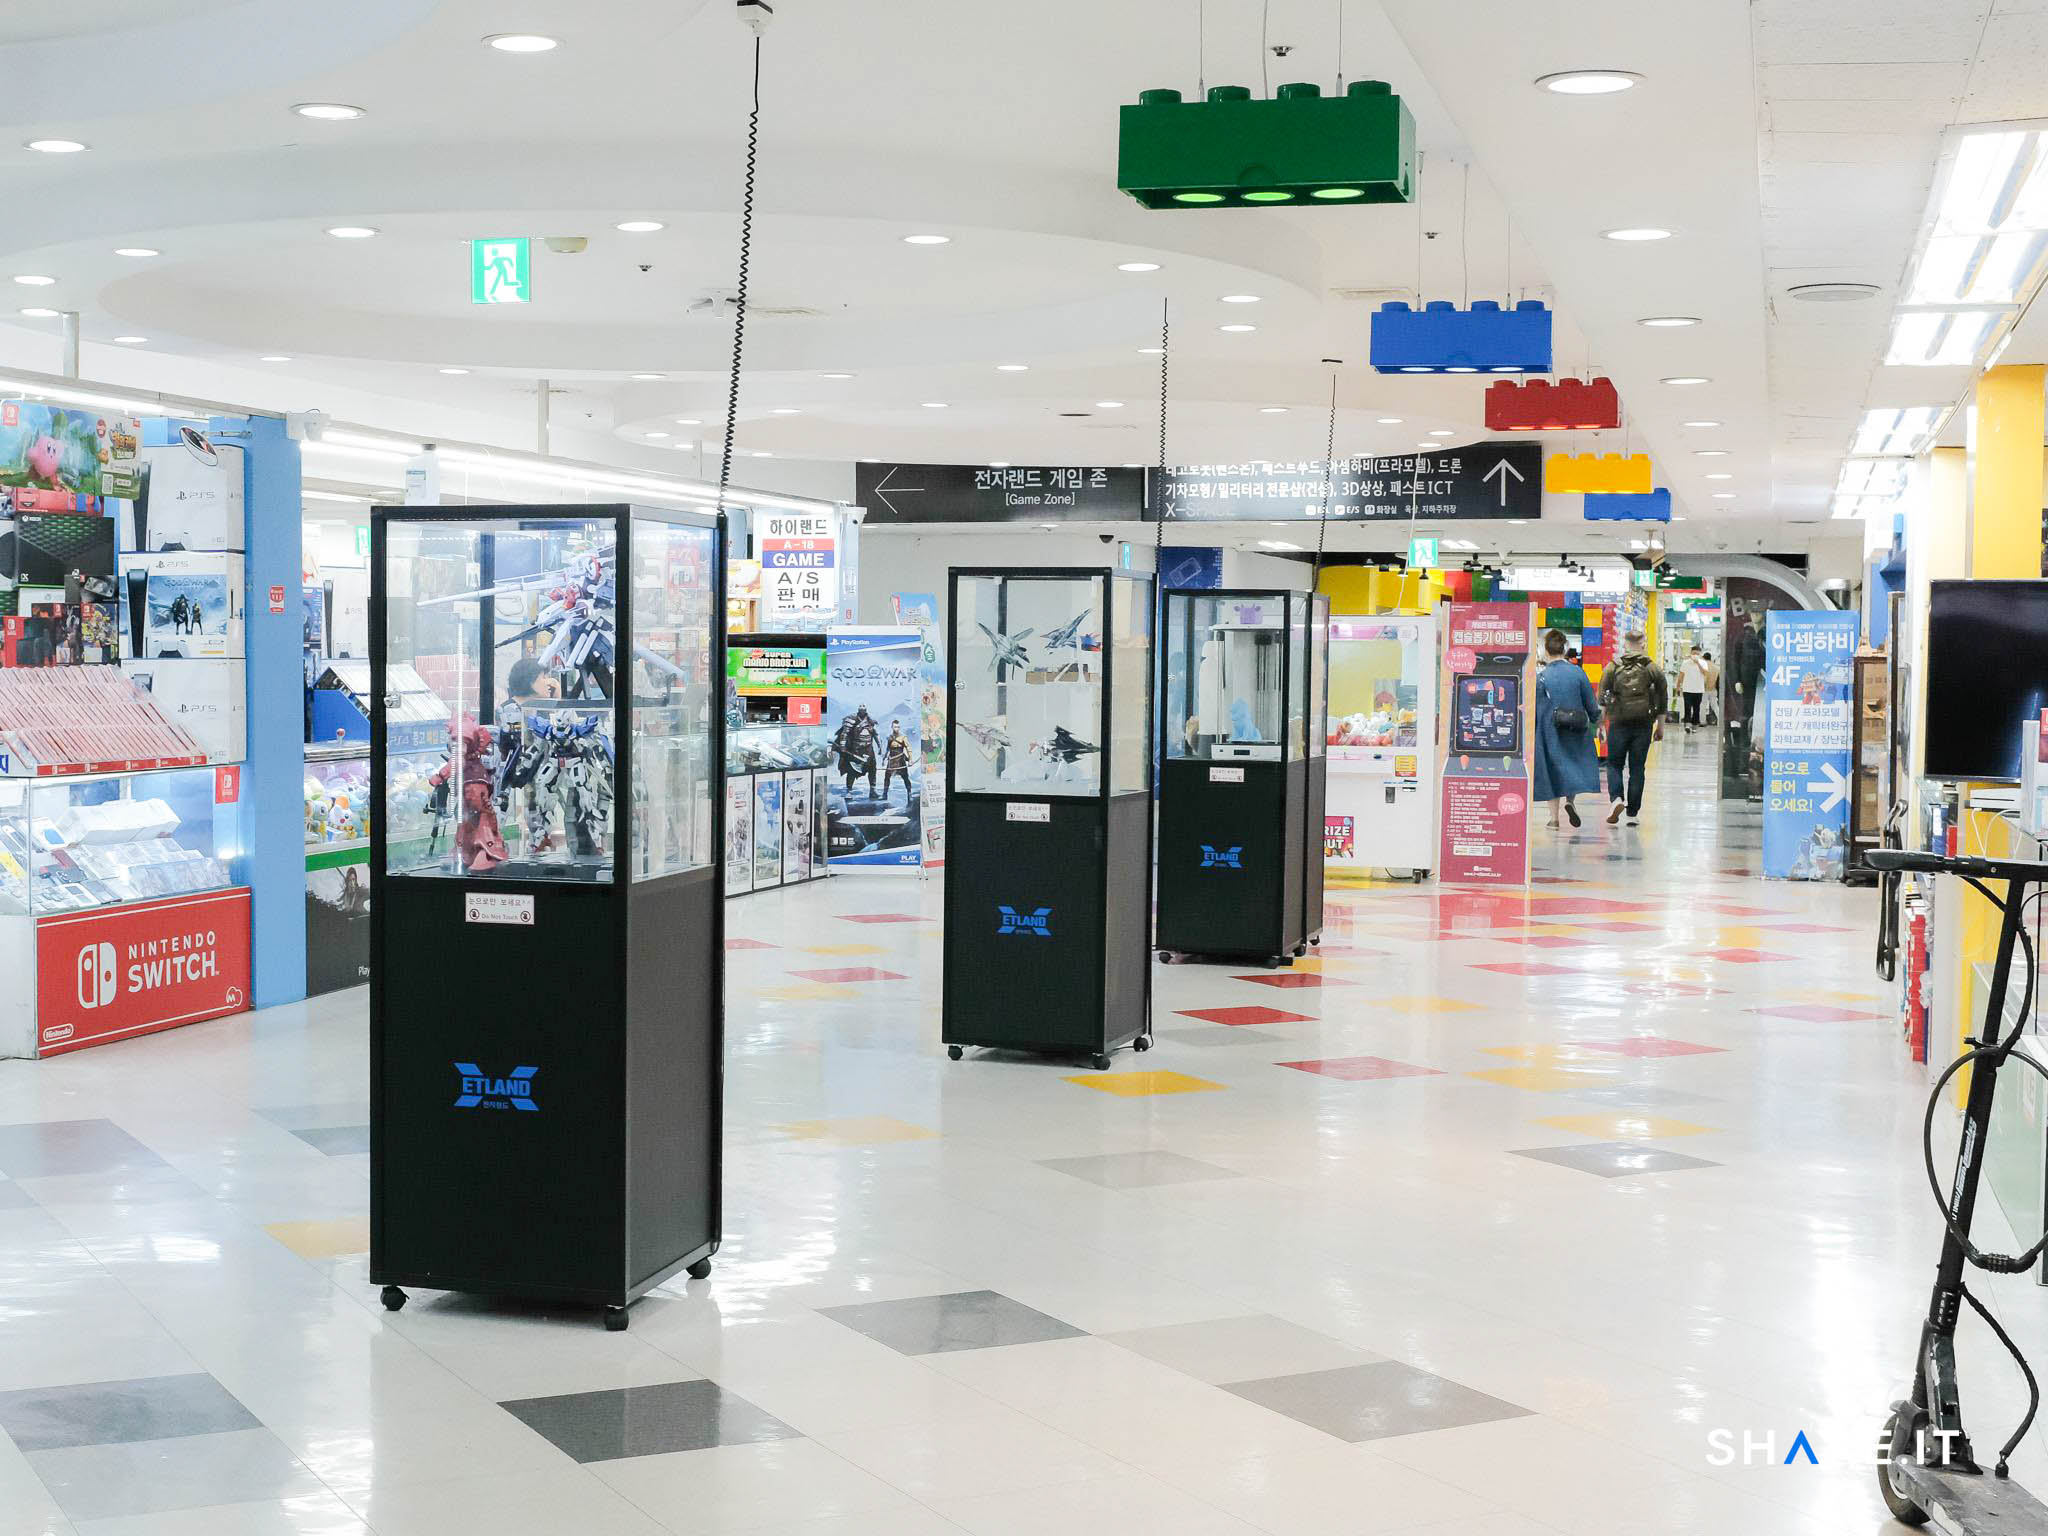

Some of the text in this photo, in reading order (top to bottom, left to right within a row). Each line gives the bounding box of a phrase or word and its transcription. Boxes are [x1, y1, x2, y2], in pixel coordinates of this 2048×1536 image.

[1438, 458, 1462, 474] 드론
[974, 468, 1108, 490] 전자랜드 게임 존
[1165, 481, 1264, 498] 기차모형/밀리터리
[1006, 493, 1076, 506] [Game Zone]
[1346, 505, 1360, 514] E/S
[770, 519, 827, 535] 하이랜드
[772, 553, 824, 567] GAME
[1771, 631, 1854, 653] 아셈하비
[831, 667, 865, 682] GOD
[882, 667, 918, 682] WAR
[1771, 665, 1800, 686] 4F
[1770, 761, 1810, 776] 안으로
[1770, 780, 1796, 794] 들어
[1770, 798, 1813, 813] 오세요!
[1002, 914, 1047, 927] ETLAND
[128, 930, 216, 960] NINTENDO
[128, 951, 217, 993] SWITCH
[462, 1077, 531, 1097] ETLAND
